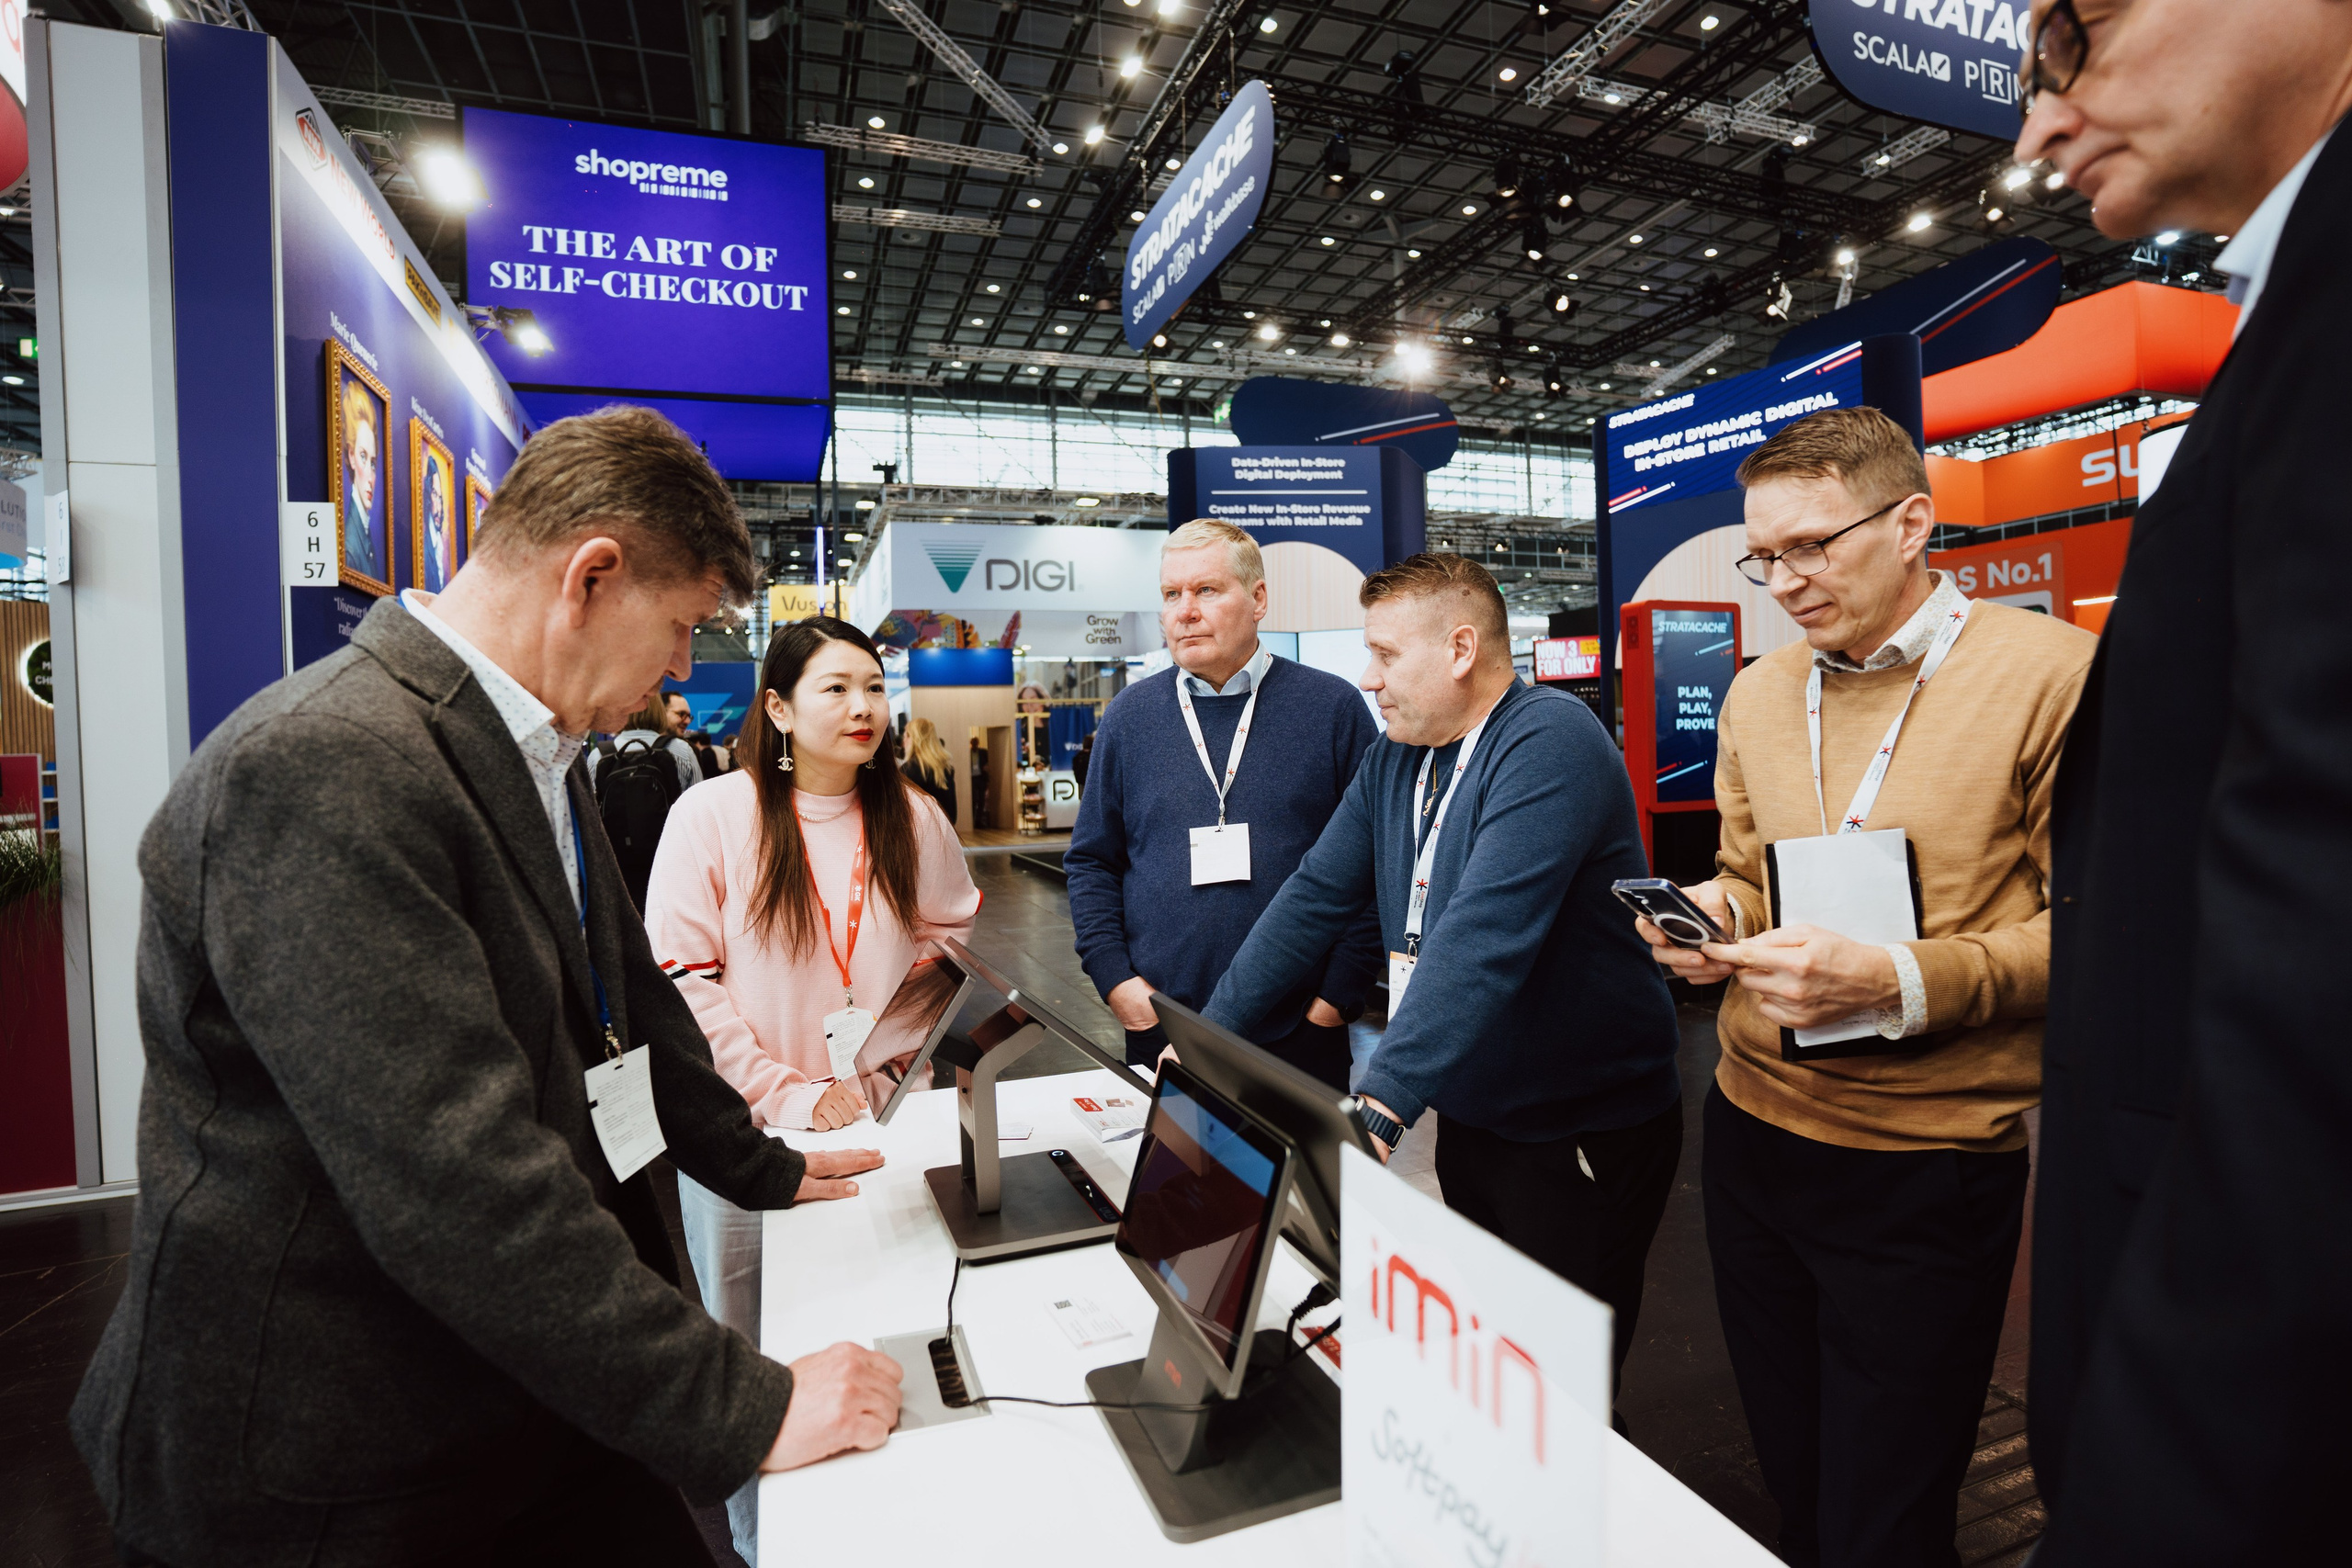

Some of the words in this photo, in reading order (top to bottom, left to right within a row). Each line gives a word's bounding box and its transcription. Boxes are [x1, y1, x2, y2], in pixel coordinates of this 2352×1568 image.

[1851, 0, 2031, 52] RATA
[1853, 31, 1932, 77] SCALA
[575, 149, 728, 188] shopreme
[1131, 105, 1256, 290] STRATACACHE
[523, 225, 616, 259] THE
[624, 235, 711, 267] ART
[721, 243, 777, 272] OF
[490, 261, 808, 310] SELF-CHECKOUT
[1608, 393, 1695, 429] STRATACACHE
[1623, 431, 1683, 458] DEPLOY
[1685, 412, 1762, 444] DYNAMIC
[1765, 391, 1838, 422] DIGITAL
[1634, 444, 1706, 471] IN-STORE
[1708, 429, 1767, 455] RETAIL
[1231, 457, 1299, 468] Data-Driven
[1301, 457, 1345, 468] In-Store
[1235, 469, 1272, 481] Digital
[1274, 469, 1343, 481] Deployment
[59, 502, 63, 519] 6
[1208, 504, 1246, 514] Create
[1248, 504, 1273, 514] New
[1275, 504, 1320, 514] In-Store
[1322, 504, 1371, 514] Revenue
[308, 511, 319, 528] 6
[1266, 516, 1293, 526] with
[1295, 516, 1327, 526] Retail
[1329, 516, 1363, 526] Media
[308, 536, 320, 552] H
[304, 562, 325, 579] 57
[986, 558, 1075, 592] DIGI
[1986, 553, 2052, 589] No.1
[782, 595, 847, 612] Vuson
[1087, 615, 1119, 626] Grow
[1658, 621, 1727, 633] STRATACACHE
[1085, 634, 1122, 644] Green
[1535, 640, 1566, 660] NOW
[1567, 639, 1577, 658] 3
[1536, 658, 1562, 677] FOR
[1564, 655, 1596, 675] ONLY
[1678, 686, 1713, 699] PLAN,
[1679, 702, 1712, 715] PLAY,
[1676, 718, 1714, 730] PROVE
[1372, 1236, 1546, 1467] imin
